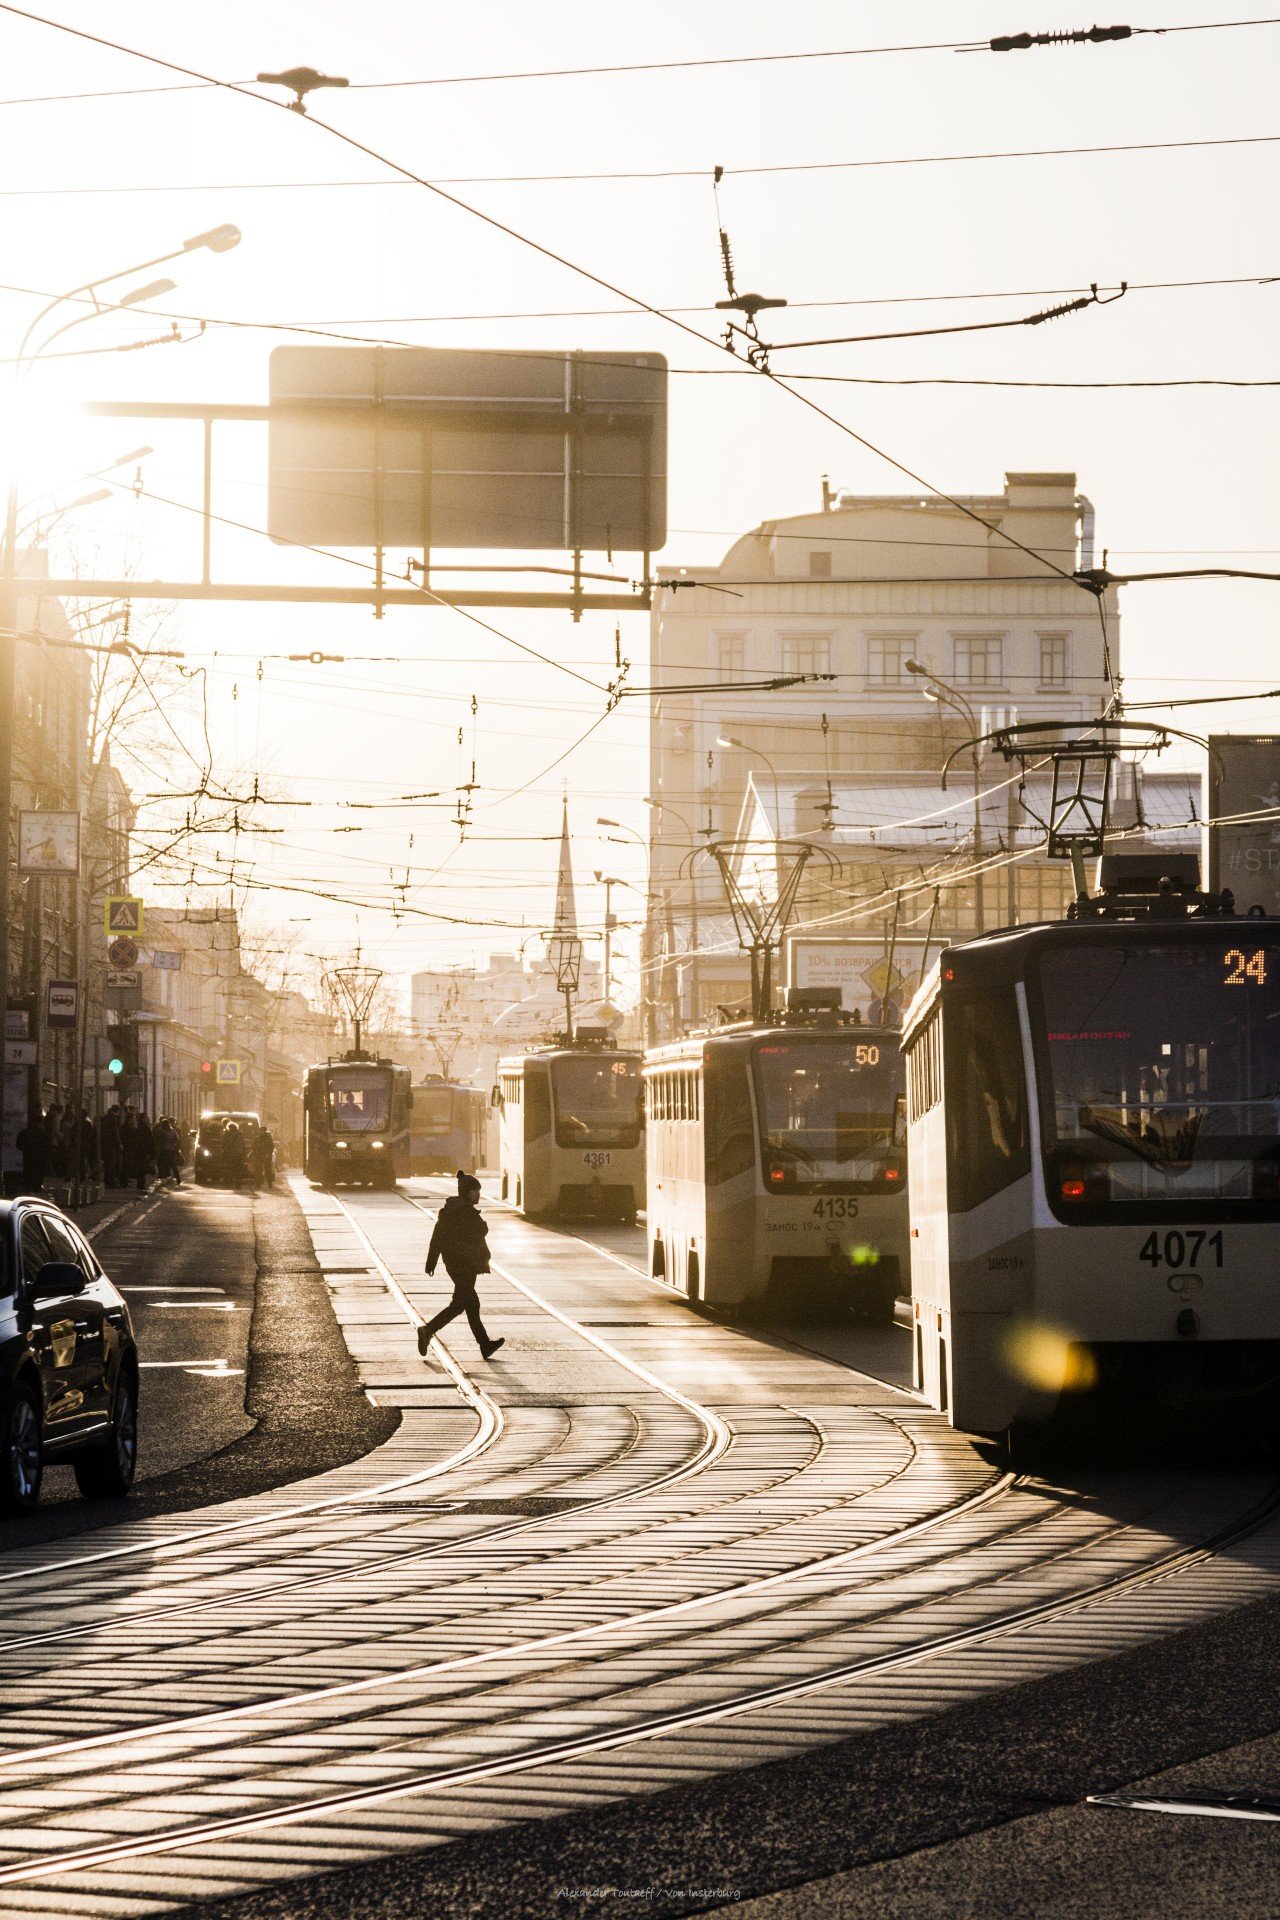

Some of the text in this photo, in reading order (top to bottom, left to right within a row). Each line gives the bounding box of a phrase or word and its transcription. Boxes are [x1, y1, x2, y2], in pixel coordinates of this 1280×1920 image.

[1224, 949, 1267, 985] 24
[855, 1045, 879, 1066] 50
[611, 1062, 626, 1075] 45
[583, 1152, 611, 1165] 4361
[812, 1197, 859, 1218] 4135
[765, 1222, 798, 1232] ЗАНОС
[1139, 1230, 1224, 1268] 4071
